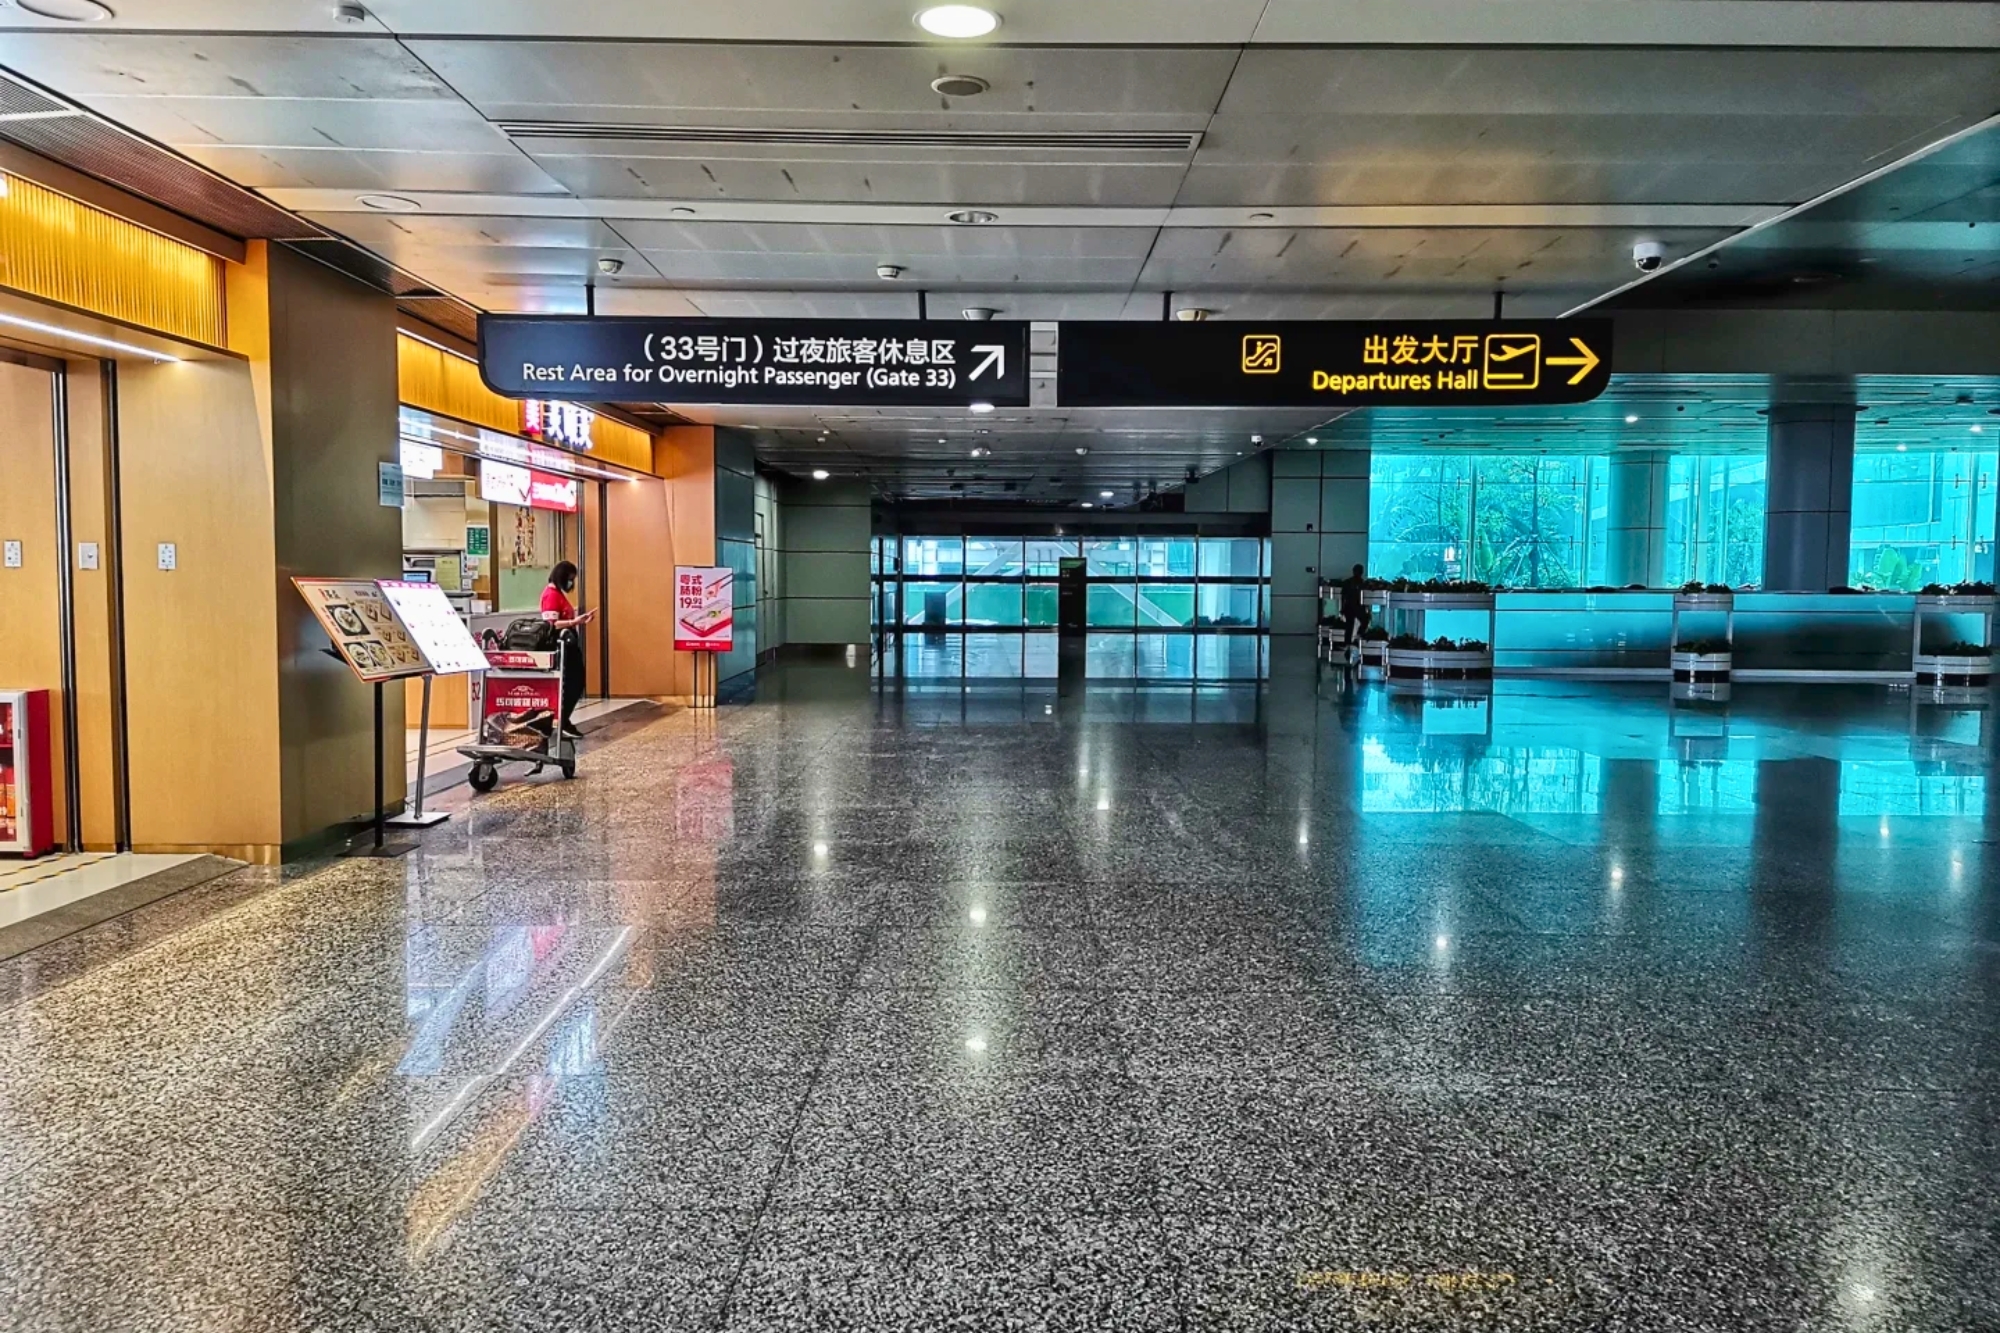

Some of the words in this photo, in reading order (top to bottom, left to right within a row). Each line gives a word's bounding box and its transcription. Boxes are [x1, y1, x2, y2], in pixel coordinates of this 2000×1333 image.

[1363, 334, 1479, 365] 出发大厅
[522, 362, 565, 382] Rest
[569, 362, 617, 383] Area
[623, 363, 654, 383] for
[658, 364, 759, 387] Overnight
[764, 367, 862, 389] Passenger
[865, 367, 921, 389] (Gate
[925, 367, 956, 389] 33)
[1312, 371, 1432, 395] Departures
[1436, 369, 1479, 390] Hall
